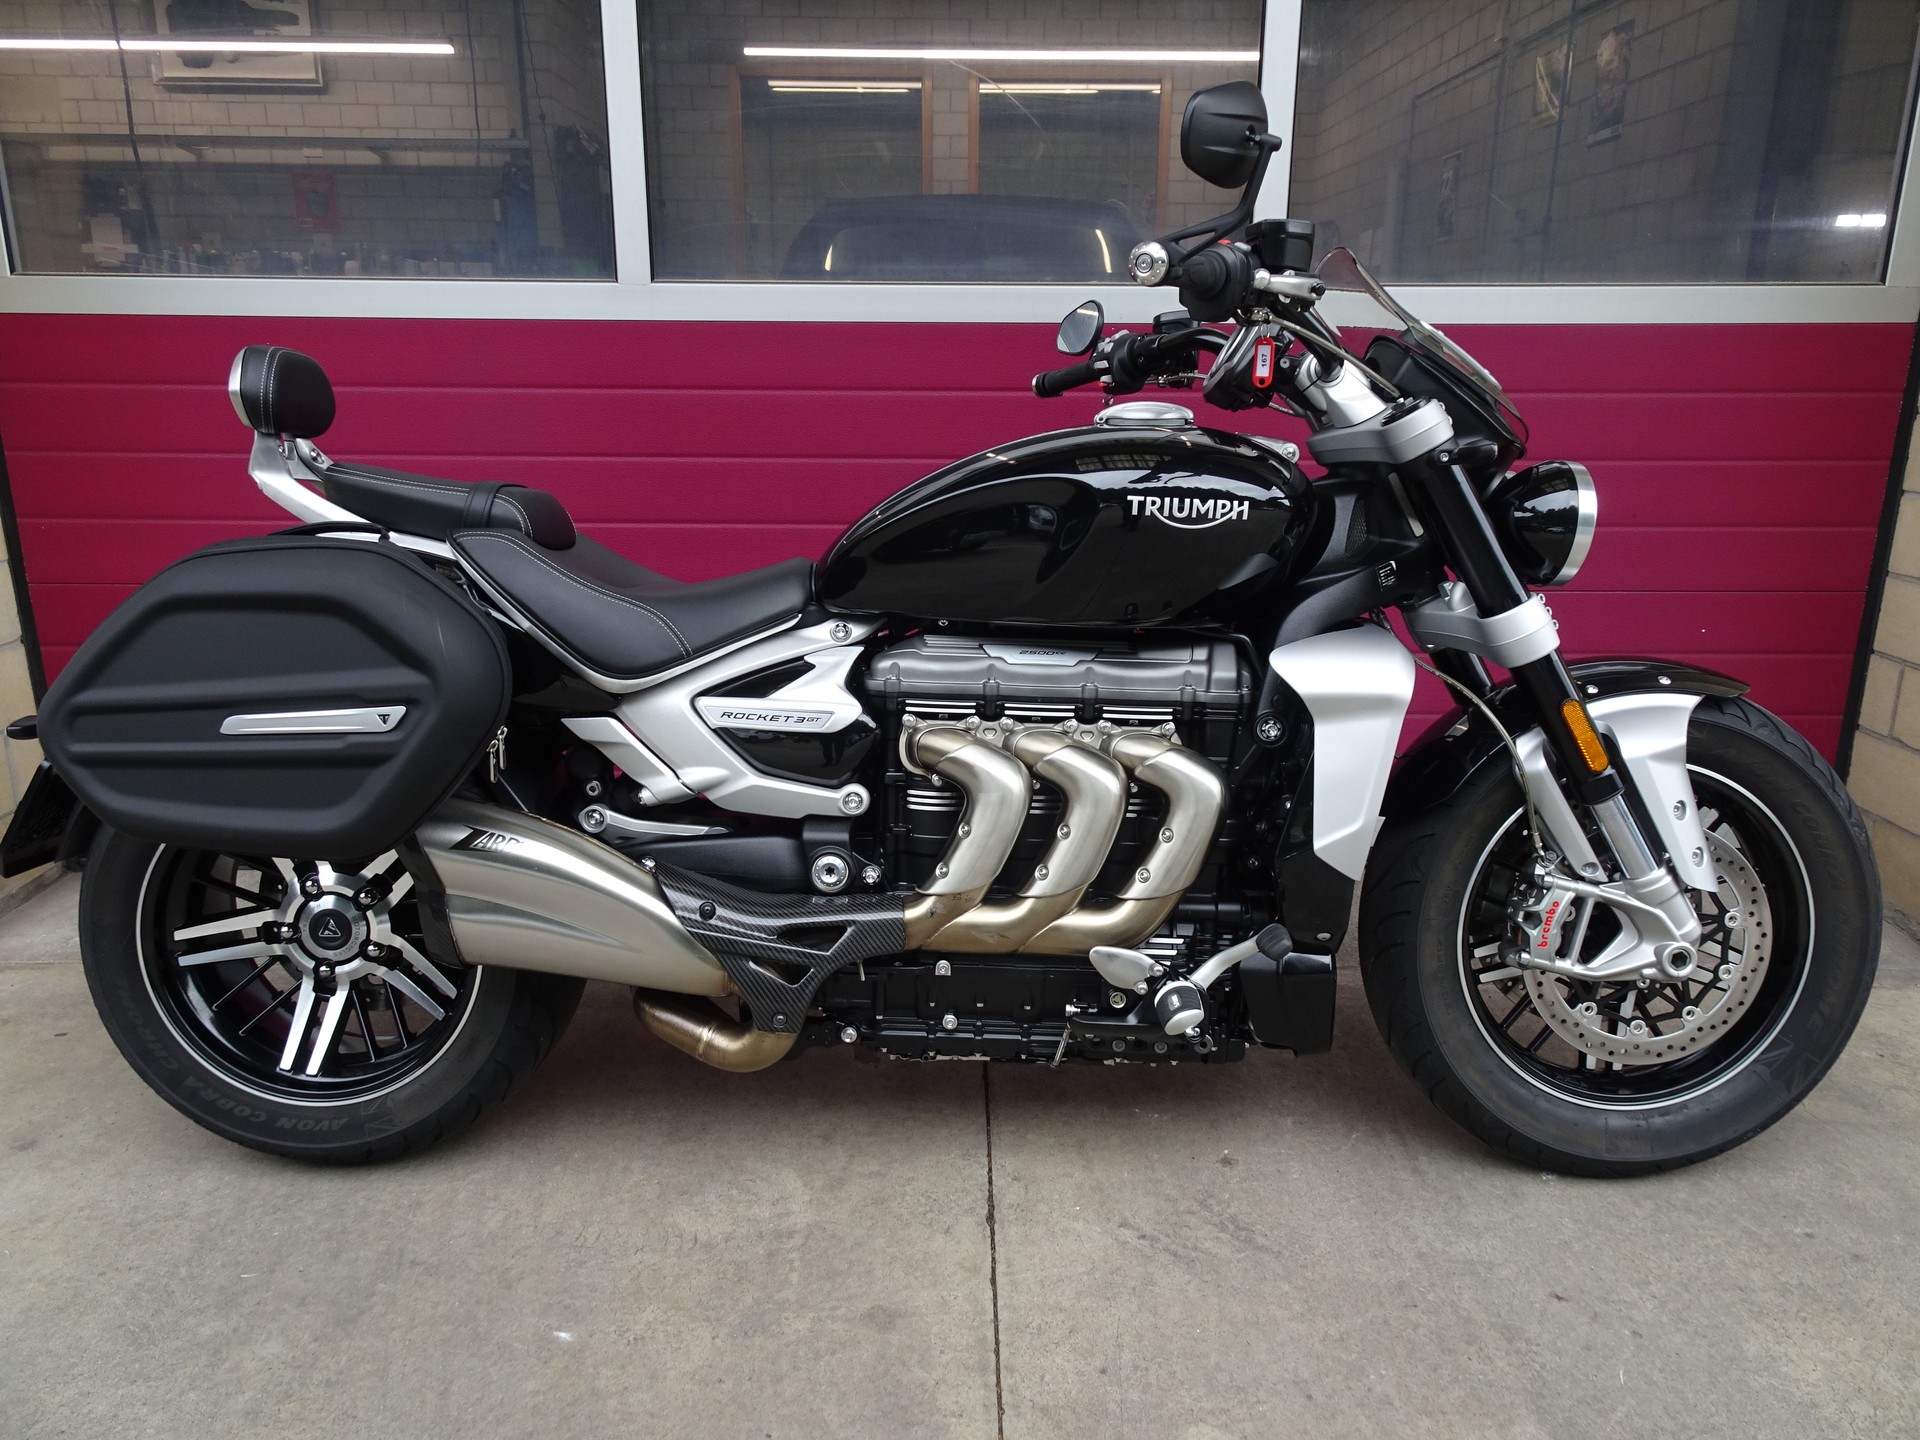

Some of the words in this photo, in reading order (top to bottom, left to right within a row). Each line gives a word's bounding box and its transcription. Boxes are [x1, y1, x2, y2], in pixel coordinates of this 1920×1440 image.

[1127, 495, 1250, 529] TRIUMPH
[1537, 900, 1560, 949] brembo
[182, 1075, 268, 1123] COBRA
[275, 1116, 350, 1132] AVON
